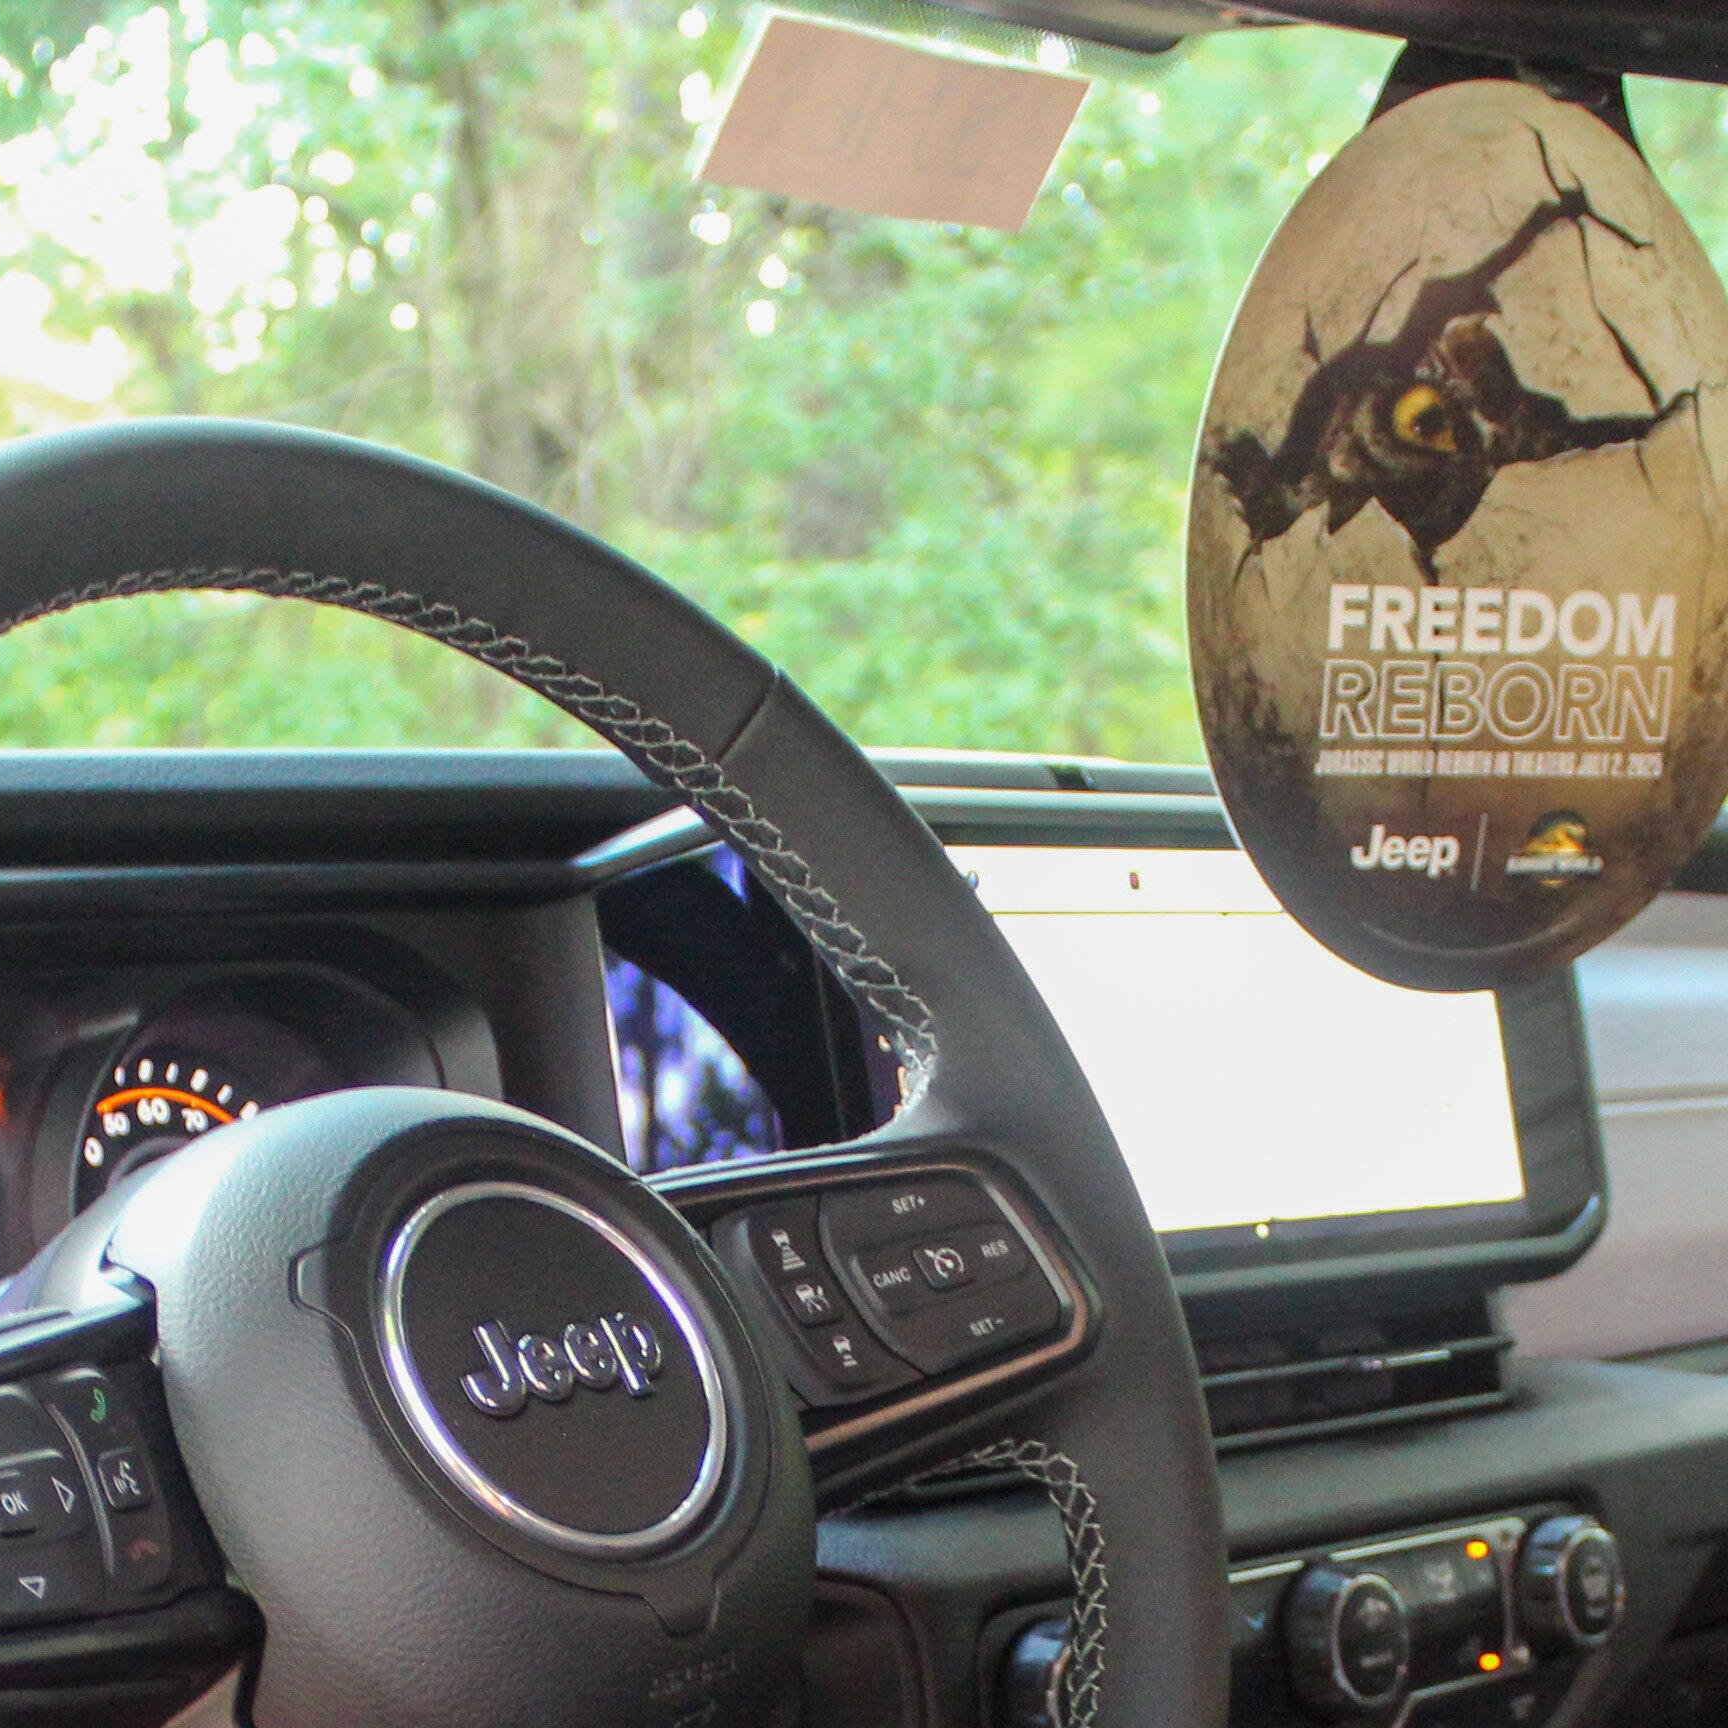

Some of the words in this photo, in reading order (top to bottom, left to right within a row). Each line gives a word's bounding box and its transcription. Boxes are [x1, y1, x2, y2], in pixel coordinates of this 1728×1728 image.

[1327, 583, 1678, 658] FREEDOM
[1319, 659, 1673, 744] REBORN
[1349, 822, 1463, 879] Jeep
[136, 1097, 171, 1126] 60
[180, 1106, 209, 1133] 70
[979, 1239, 1009, 1259] RES
[873, 1266, 913, 1290] CANC
[458, 1311, 664, 1419] Jeep
[0, 1489, 31, 1516] OK
